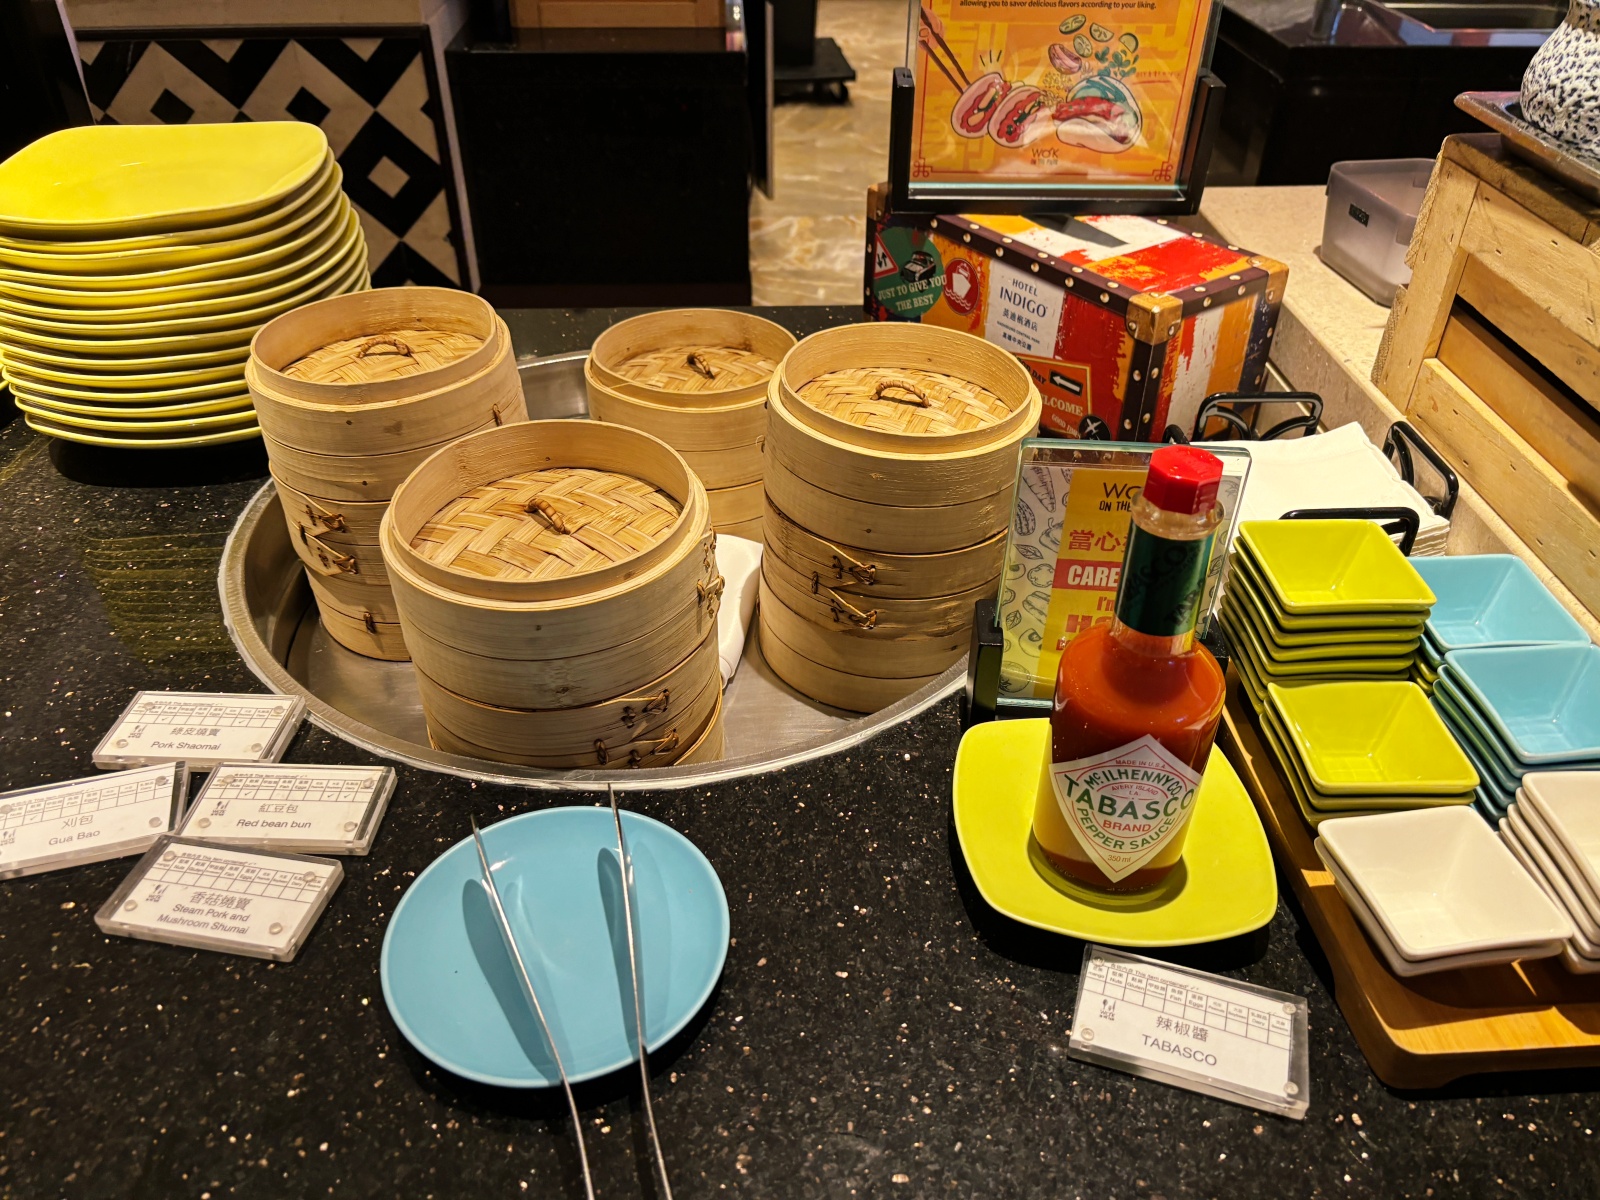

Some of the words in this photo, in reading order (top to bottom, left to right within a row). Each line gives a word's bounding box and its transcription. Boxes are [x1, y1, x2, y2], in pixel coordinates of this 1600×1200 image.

[960, 0, 987, 8] allowing
[1080, 0, 1112, 9] according
[878, 287, 896, 300] JUST
[896, 284, 908, 295] TO
[909, 279, 928, 293] GIVE
[929, 274, 948, 287] YOU
[1012, 278, 1038, 296] HOTEL
[896, 300, 912, 311] THE
[912, 294, 934, 307] BEST
[1000, 286, 1047, 317] INDIGO
[1099, 500, 1112, 512] ON
[150, 741, 175, 749] Pork
[176, 741, 222, 750] Shaomai
[1064, 774, 1195, 820] TABASCO
[1135, 785, 1159, 795] ISLAND
[258, 803, 299, 813] 紅豆包
[61, 814, 94, 829] 刈包
[236, 819, 259, 827] Red
[261, 820, 288, 828] bean
[290, 820, 312, 828] bun
[1077, 807, 1125, 850] PEPPER
[1129, 817, 1176, 850] SAUCE
[1103, 819, 1151, 832] BRAND
[48, 836, 73, 845] Gua
[77, 830, 101, 840] Bao
[1107, 854, 1121, 862] 350
[172, 903, 205, 915] Steam
[205, 908, 229, 919] Pork
[229, 913, 251, 922] and
[157, 913, 210, 929] Mushroom
[210, 921, 250, 934] Shumai
[1156, 1015, 1209, 1042] 辣椒醬
[1141, 1033, 1217, 1066] TABASCO
